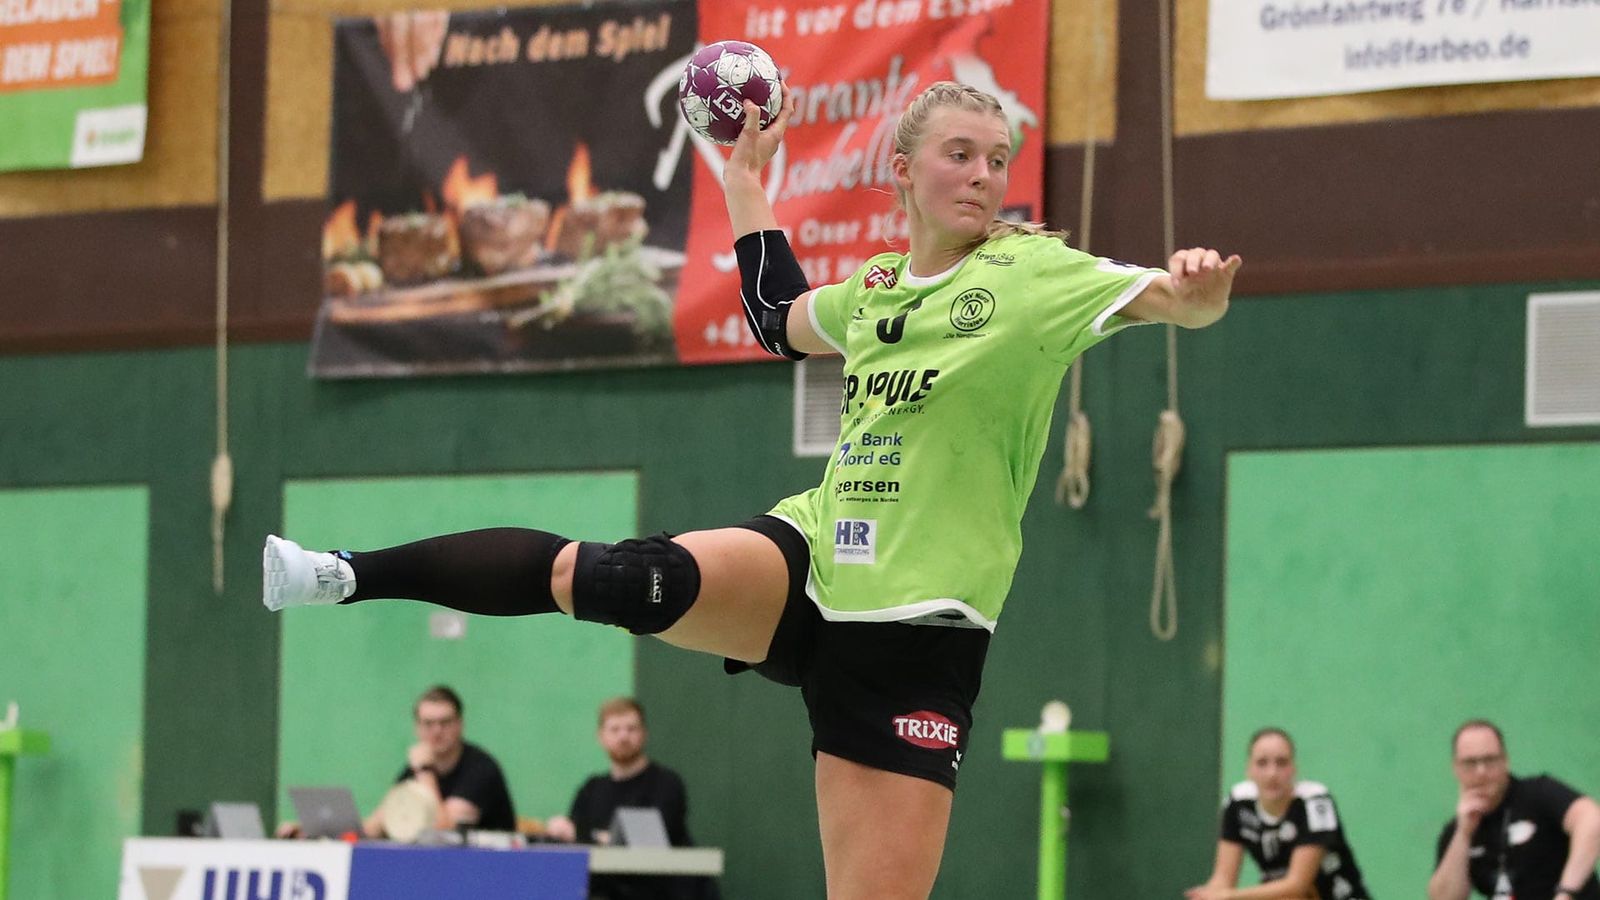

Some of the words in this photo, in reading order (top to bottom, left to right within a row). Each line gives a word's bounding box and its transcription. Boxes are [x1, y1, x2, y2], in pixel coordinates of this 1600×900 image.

[795, 5, 847, 36] vor
[853, 0, 921, 30] dem
[527, 24, 589, 63] dem
[596, 12, 672, 63] Spiel
[1344, 33, 1532, 69] info@farbeo.de
[965, 304, 979, 317] N
[861, 432, 903, 446] Bank
[879, 451, 901, 466] eG
